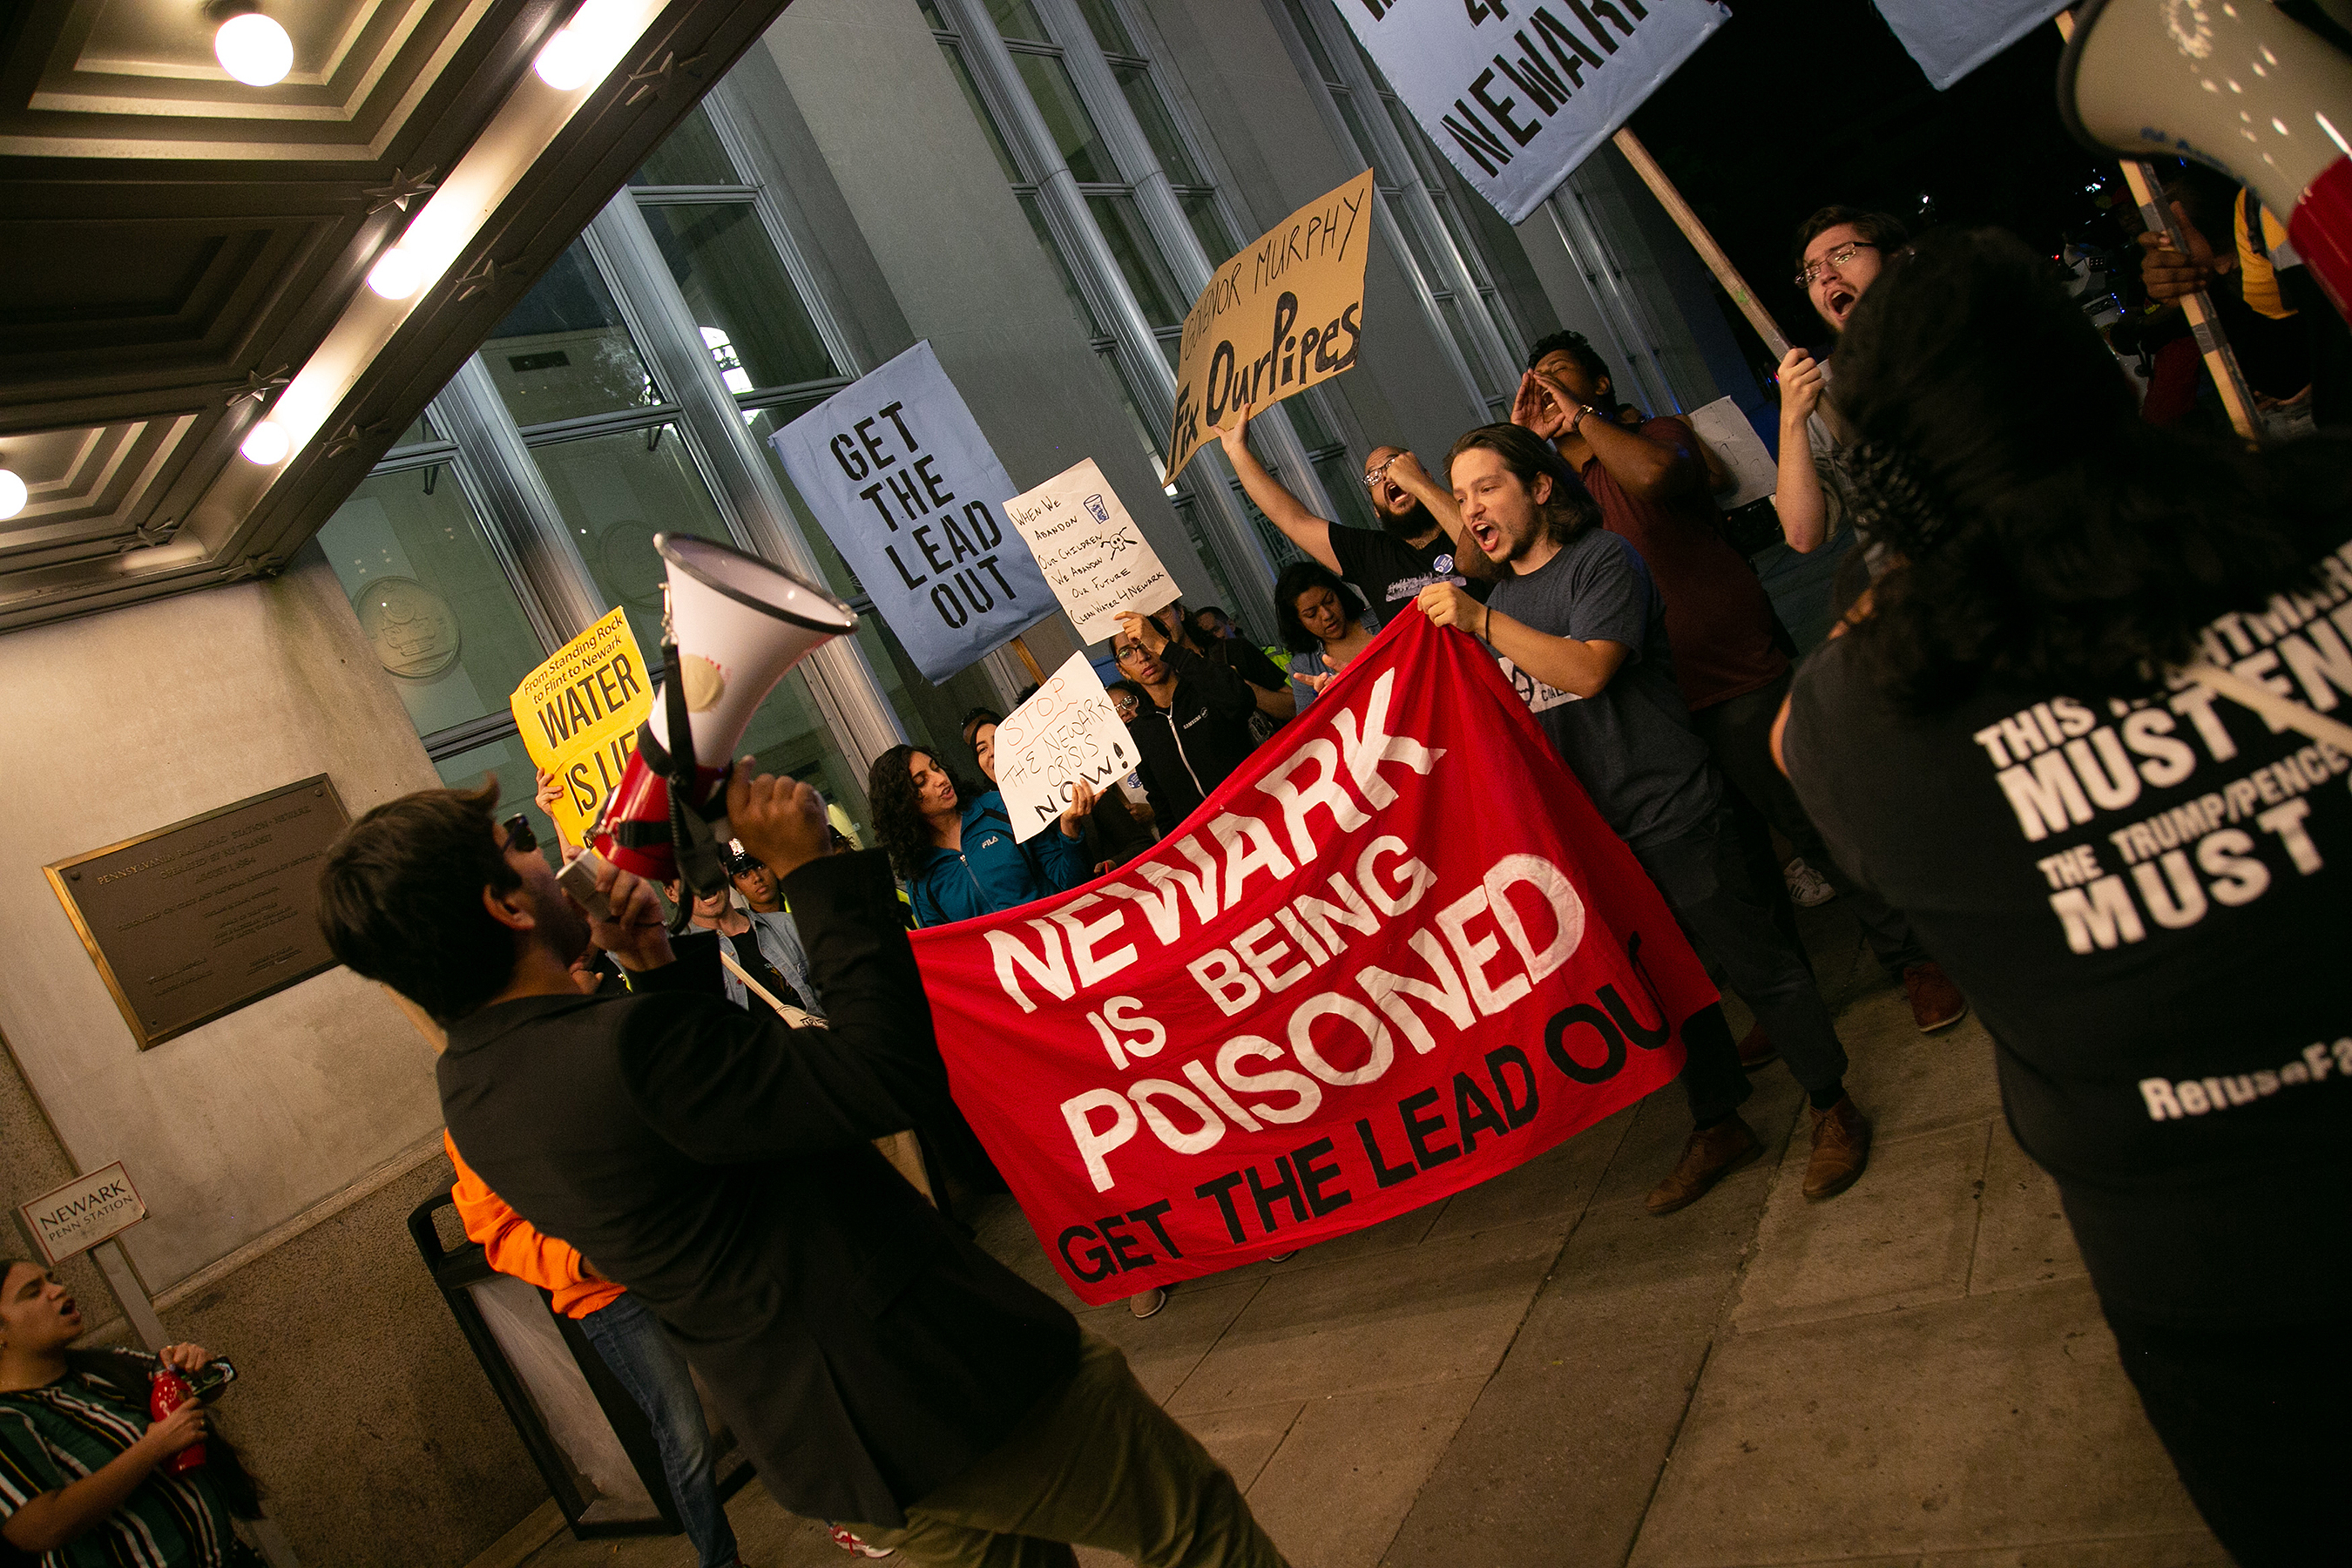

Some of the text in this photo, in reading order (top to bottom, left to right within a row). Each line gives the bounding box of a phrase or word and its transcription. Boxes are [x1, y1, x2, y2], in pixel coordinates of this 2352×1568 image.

[1254, 188, 1365, 294] MURPHY
[830, 400, 919, 481] GET
[860, 454, 956, 532] THE
[885, 499, 1003, 591] LEAD
[930, 555, 1017, 629] OUT
[524, 615, 624, 696] From Standing Rock
[533, 635, 622, 705] to Flint to Newark
[537, 652, 641, 750] WATER
[1002, 696, 1112, 787] THE NEWARK
[1004, 677, 1065, 747] STOP
[1974, 696, 2096, 770] THIS
[1996, 599, 2352, 841] MUST EN
[565, 727, 636, 818] IS LIF
[1047, 733, 1099, 787] CRISIS
[982, 835, 999, 849] FILA
[983, 667, 1446, 1013] NEWARK
[2038, 742, 2351, 890] THE TRUMP/PENCE
[2049, 796, 2324, 955] MUST
[1087, 835, 1437, 1071] IS BEING
[1060, 853, 1585, 1193] POISONED
[1058, 931, 1670, 1284] GET THE LEAD OU
[39, 1179, 126, 1231] NEWARK
[49, 1194, 132, 1241] PENN STATION
